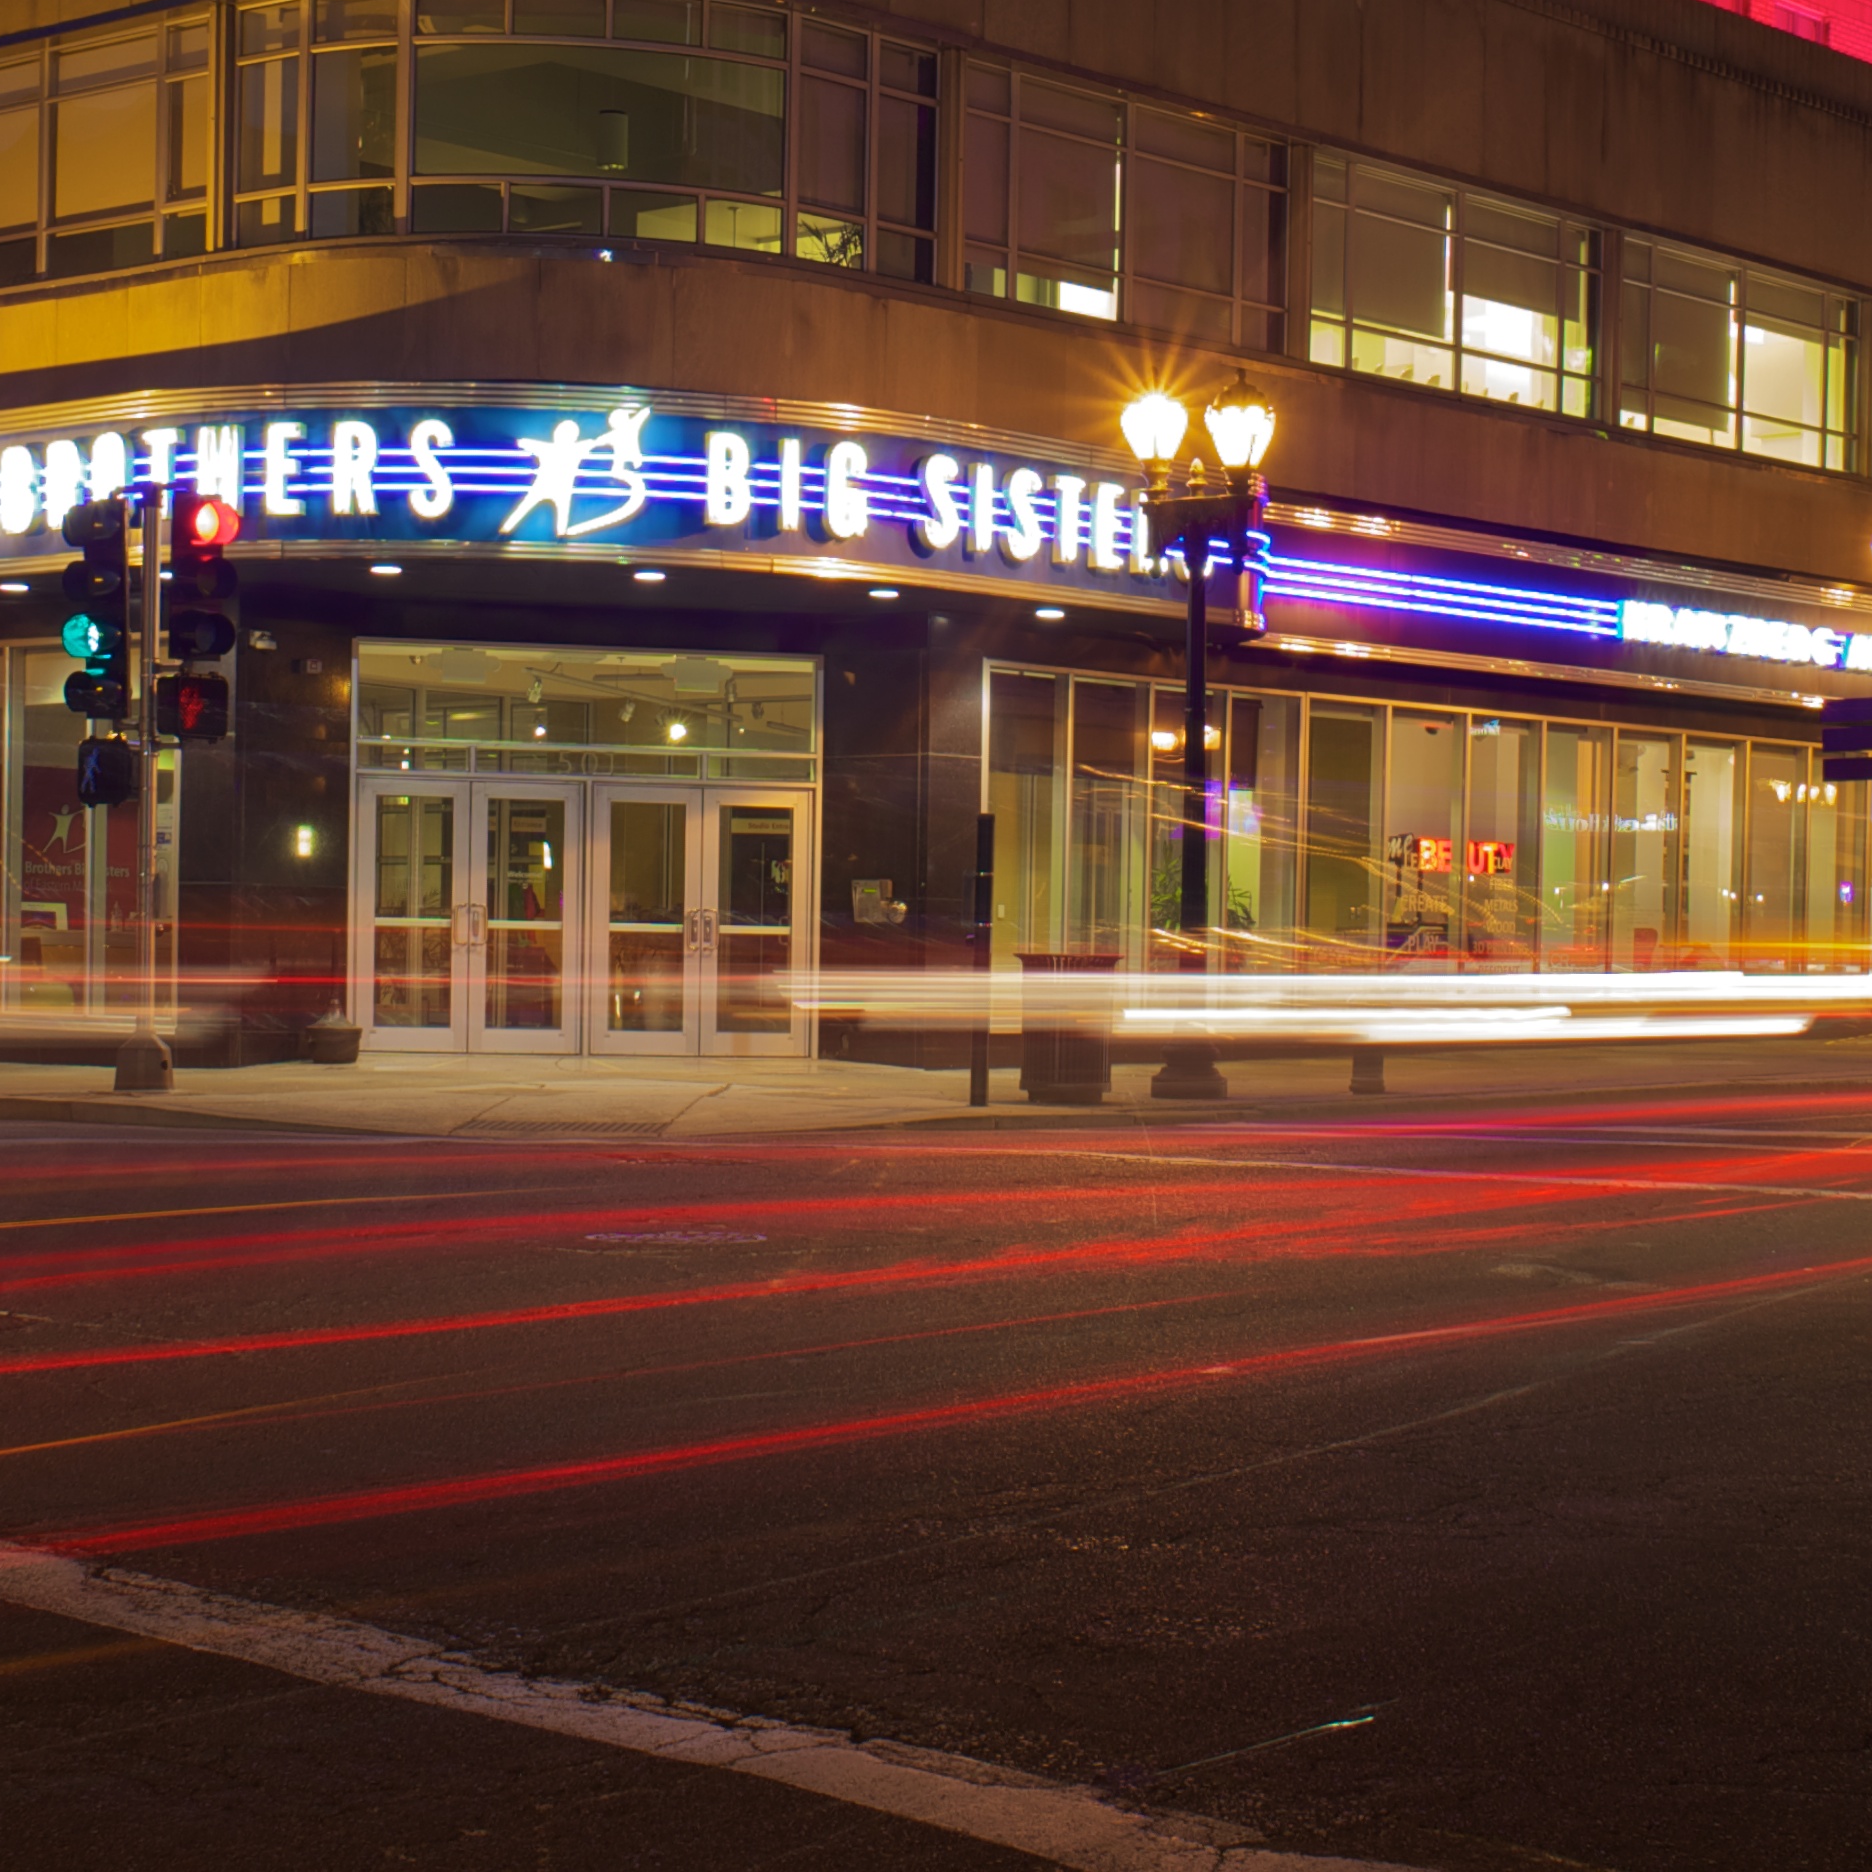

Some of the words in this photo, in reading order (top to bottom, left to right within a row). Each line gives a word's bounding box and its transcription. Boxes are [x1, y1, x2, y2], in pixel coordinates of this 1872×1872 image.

[704, 430, 870, 539] BIG
[921, 452, 1212, 583] SISTE
[24, 860, 72, 877] Brothers
[1417, 837, 1516, 875] BEUTY
